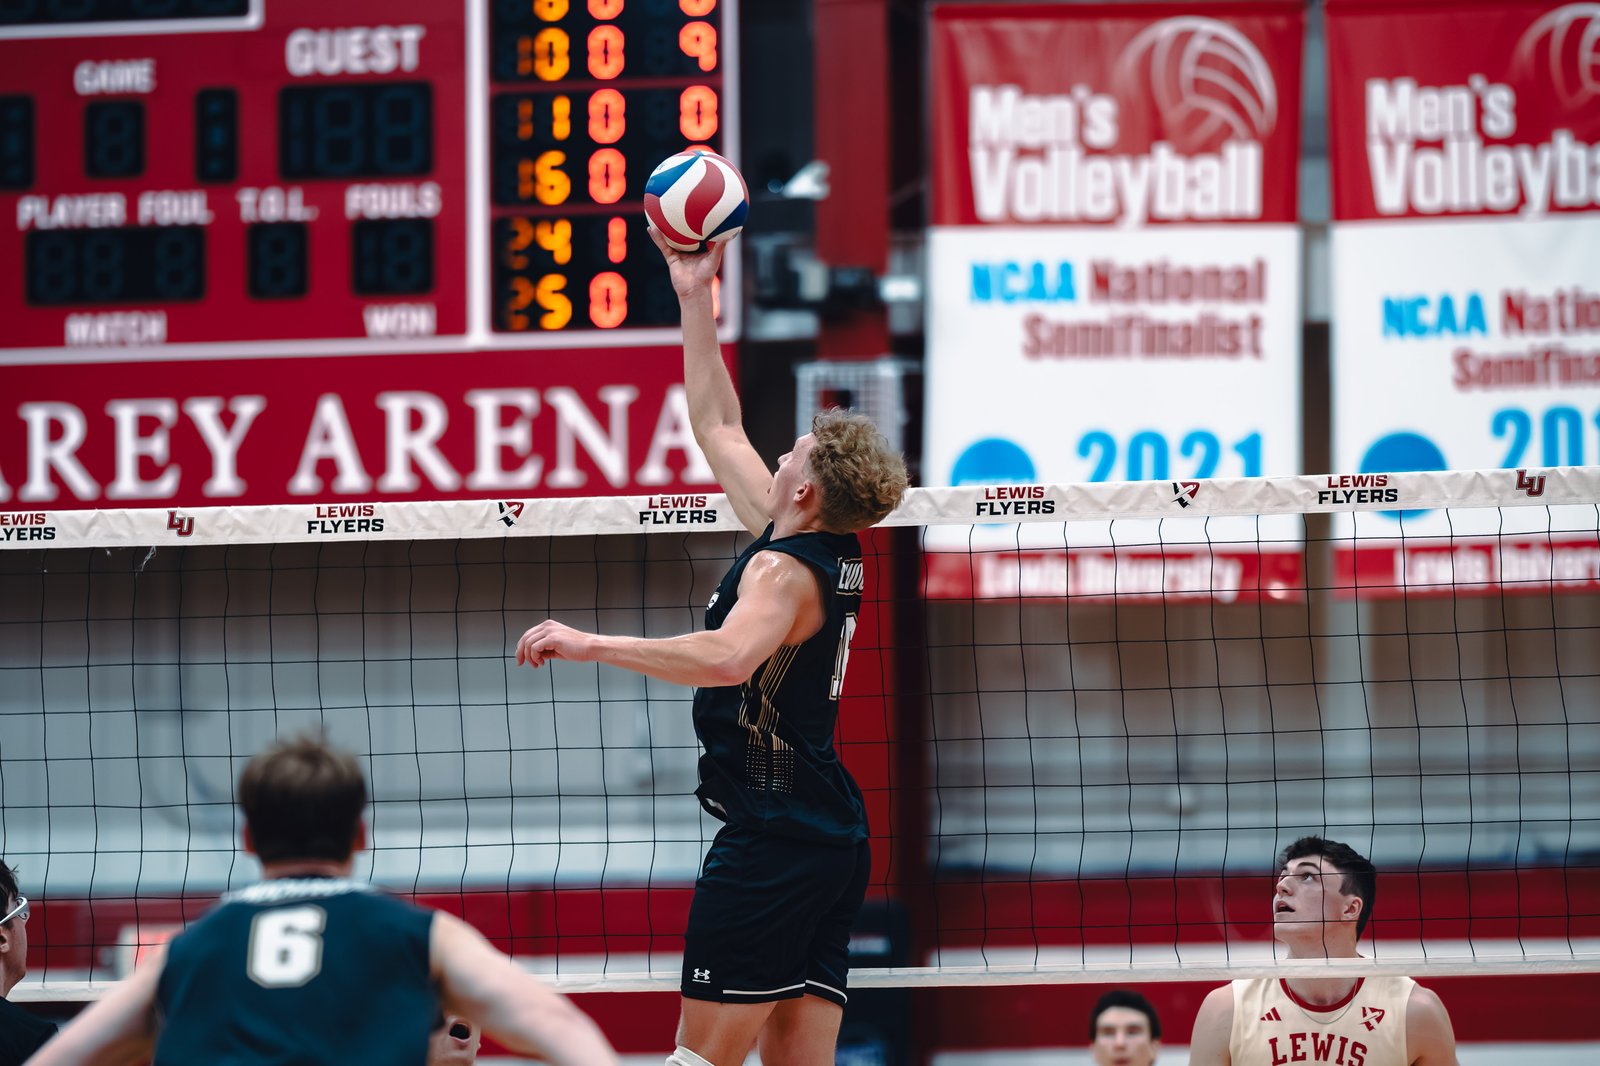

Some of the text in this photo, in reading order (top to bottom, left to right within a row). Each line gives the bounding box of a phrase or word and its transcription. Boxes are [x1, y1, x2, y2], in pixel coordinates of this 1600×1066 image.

[285, 26, 425, 76] GUEST
[74, 59, 156, 95] GAME
[588, 88, 626, 144] 0
[680, 85, 718, 141] 0
[969, 83, 1119, 148] Men's
[1365, 74, 1516, 141] Men's
[588, 148, 626, 204] 0
[968, 140, 1263, 231] Volleyball
[17, 190, 214, 230] PLAYER FOUL
[345, 182, 442, 219] FOULS
[589, 271, 628, 328] 0
[969, 257, 1267, 306] NCAA National
[65, 311, 167, 346] MATCH
[363, 304, 438, 338] WON
[1022, 311, 1265, 361] Semifinalist
[1381, 292, 1489, 339] NCAA
[0, 383, 716, 502] REY ARENA
[1075, 428, 1265, 483] 2021
[1491, 404, 1600, 469] 20
[649, 496, 707, 509] LEWIS
[985, 486, 1045, 500] LEWIS
[1318, 489, 1398, 505] FLYERS
[1327, 475, 1388, 488] LEWIS
[307, 518, 384, 534] FLYERS
[316, 505, 374, 518] LEWIS
[639, 509, 717, 525] FLYERS
[976, 500, 1055, 516] FLYERS
[0, 527, 56, 541] YERS
[977, 553, 1243, 603] Lewis University
[1393, 545, 1490, 592] Lewis
[248, 903, 326, 988] 6
[1268, 1032, 1367, 1066] LEWIS
